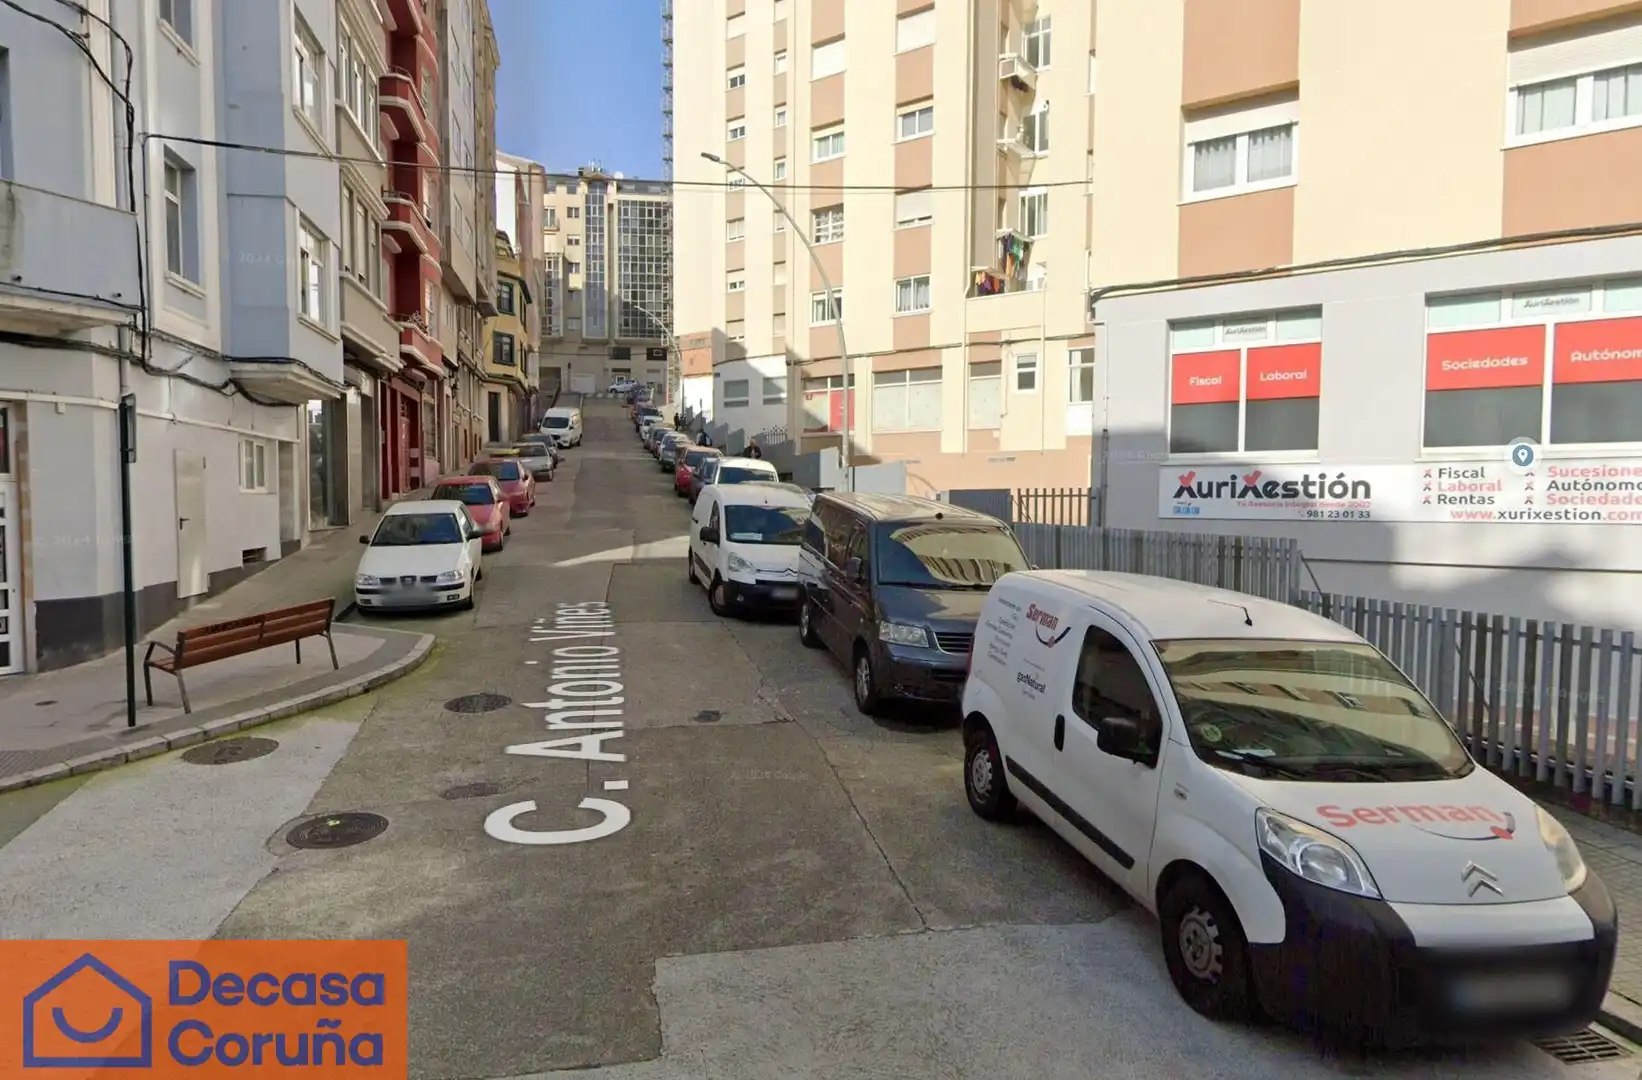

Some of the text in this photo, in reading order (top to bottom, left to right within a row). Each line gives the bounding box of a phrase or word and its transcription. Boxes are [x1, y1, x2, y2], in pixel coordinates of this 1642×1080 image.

[1441, 355, 1529, 371] Sociedades
[1189, 375, 1223, 386] Fiscal
[1259, 369, 1308, 382] Laboral
[1438, 466, 1485, 479] Fiscal
[1438, 479, 1502, 492] Laboral
[1437, 494, 1495, 505] Rentas
[1306, 510, 1371, 518] 981 23 01 33
[1026, 604, 1059, 630] Serman
[1316, 805, 1505, 828] Serman
